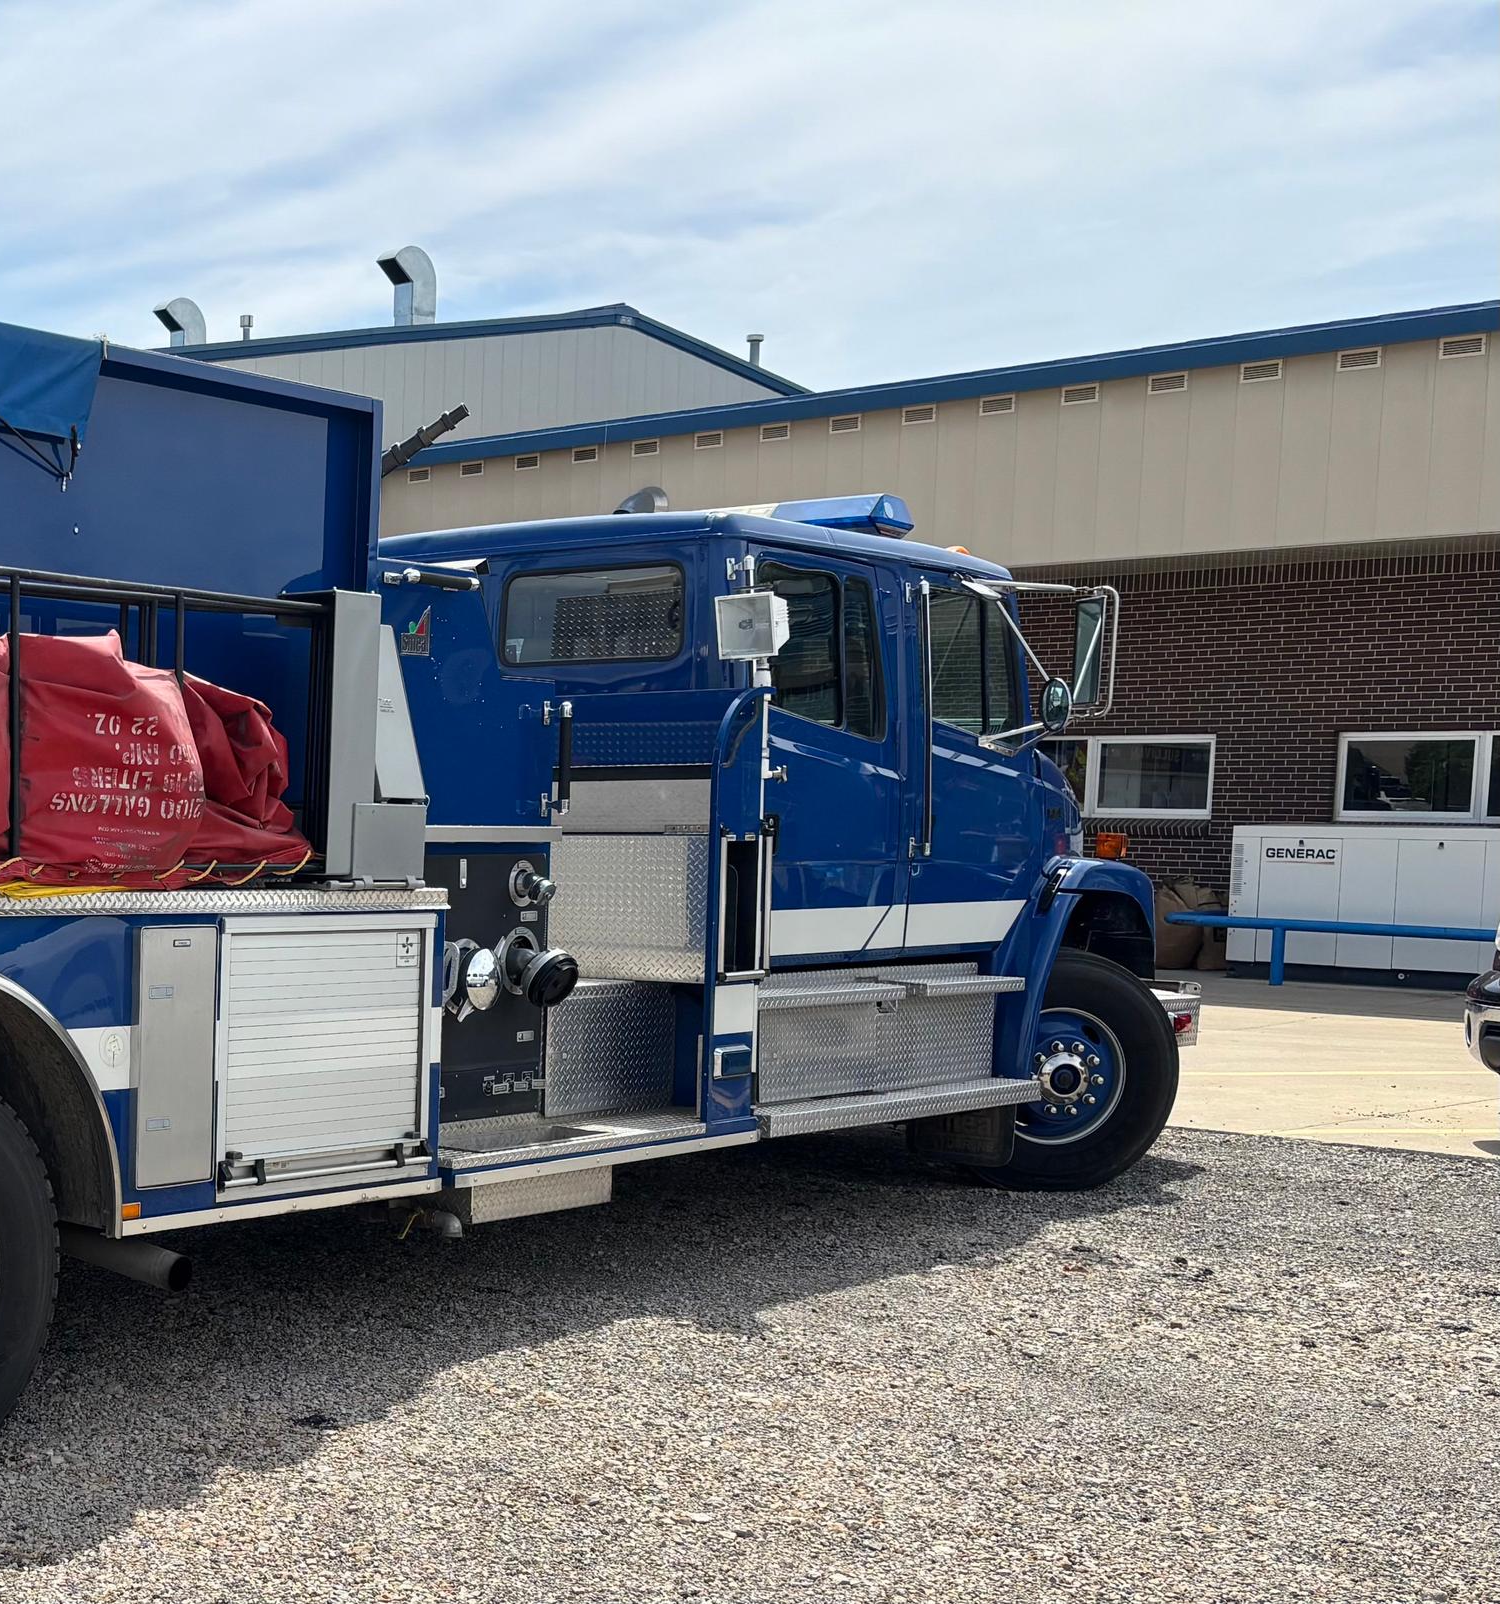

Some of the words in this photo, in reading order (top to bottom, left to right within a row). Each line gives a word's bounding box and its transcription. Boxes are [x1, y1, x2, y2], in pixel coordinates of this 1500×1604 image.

[131, 716, 159, 736] 22
[72, 766, 154, 791] LITERS
[50, 792, 151, 818] GALLONS
[1266, 847, 1336, 859] GENERAC
